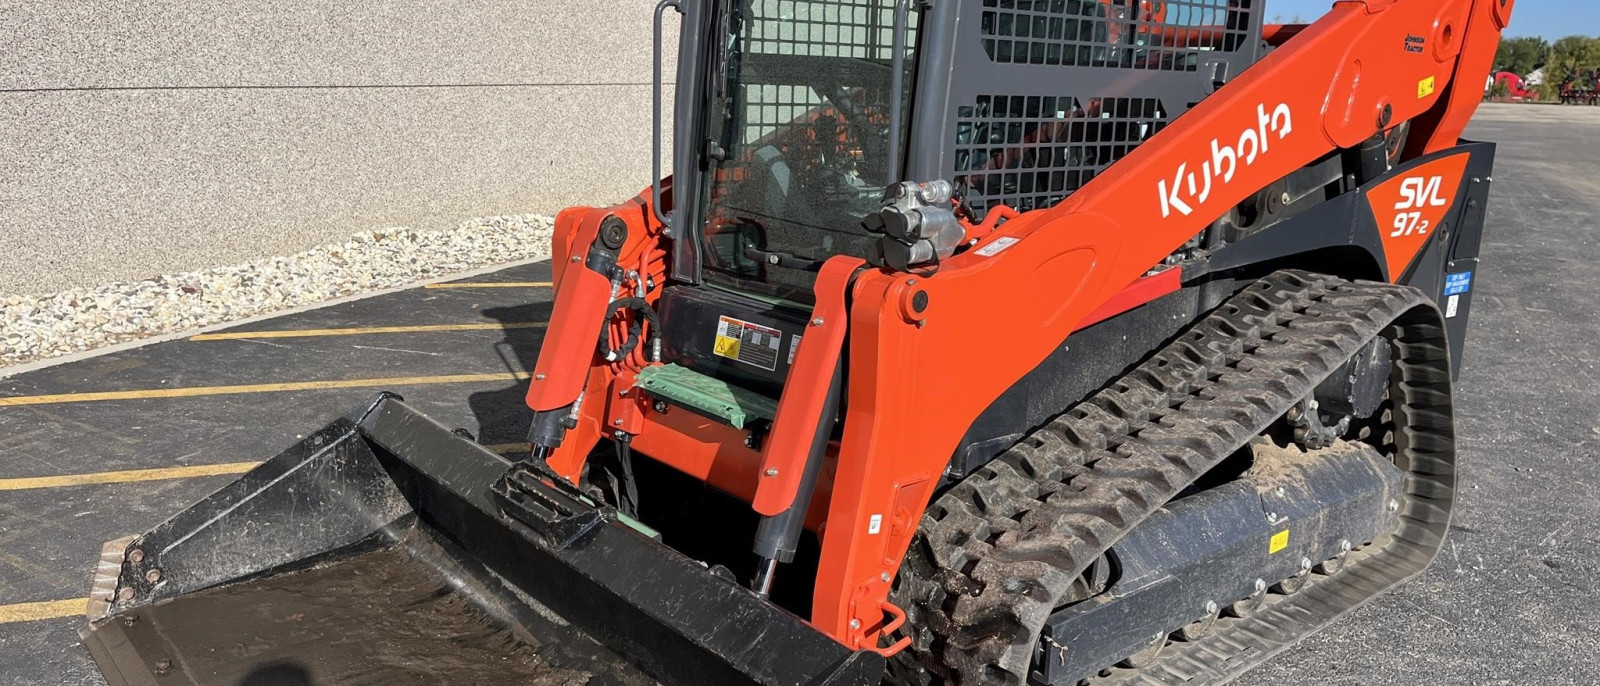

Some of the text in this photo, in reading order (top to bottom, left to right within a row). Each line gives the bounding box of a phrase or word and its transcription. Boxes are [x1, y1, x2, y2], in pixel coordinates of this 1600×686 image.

[1157, 102, 1292, 218] Kubota
[1394, 175, 1446, 210] SVL
[1390, 211, 1429, 238] 97-2
